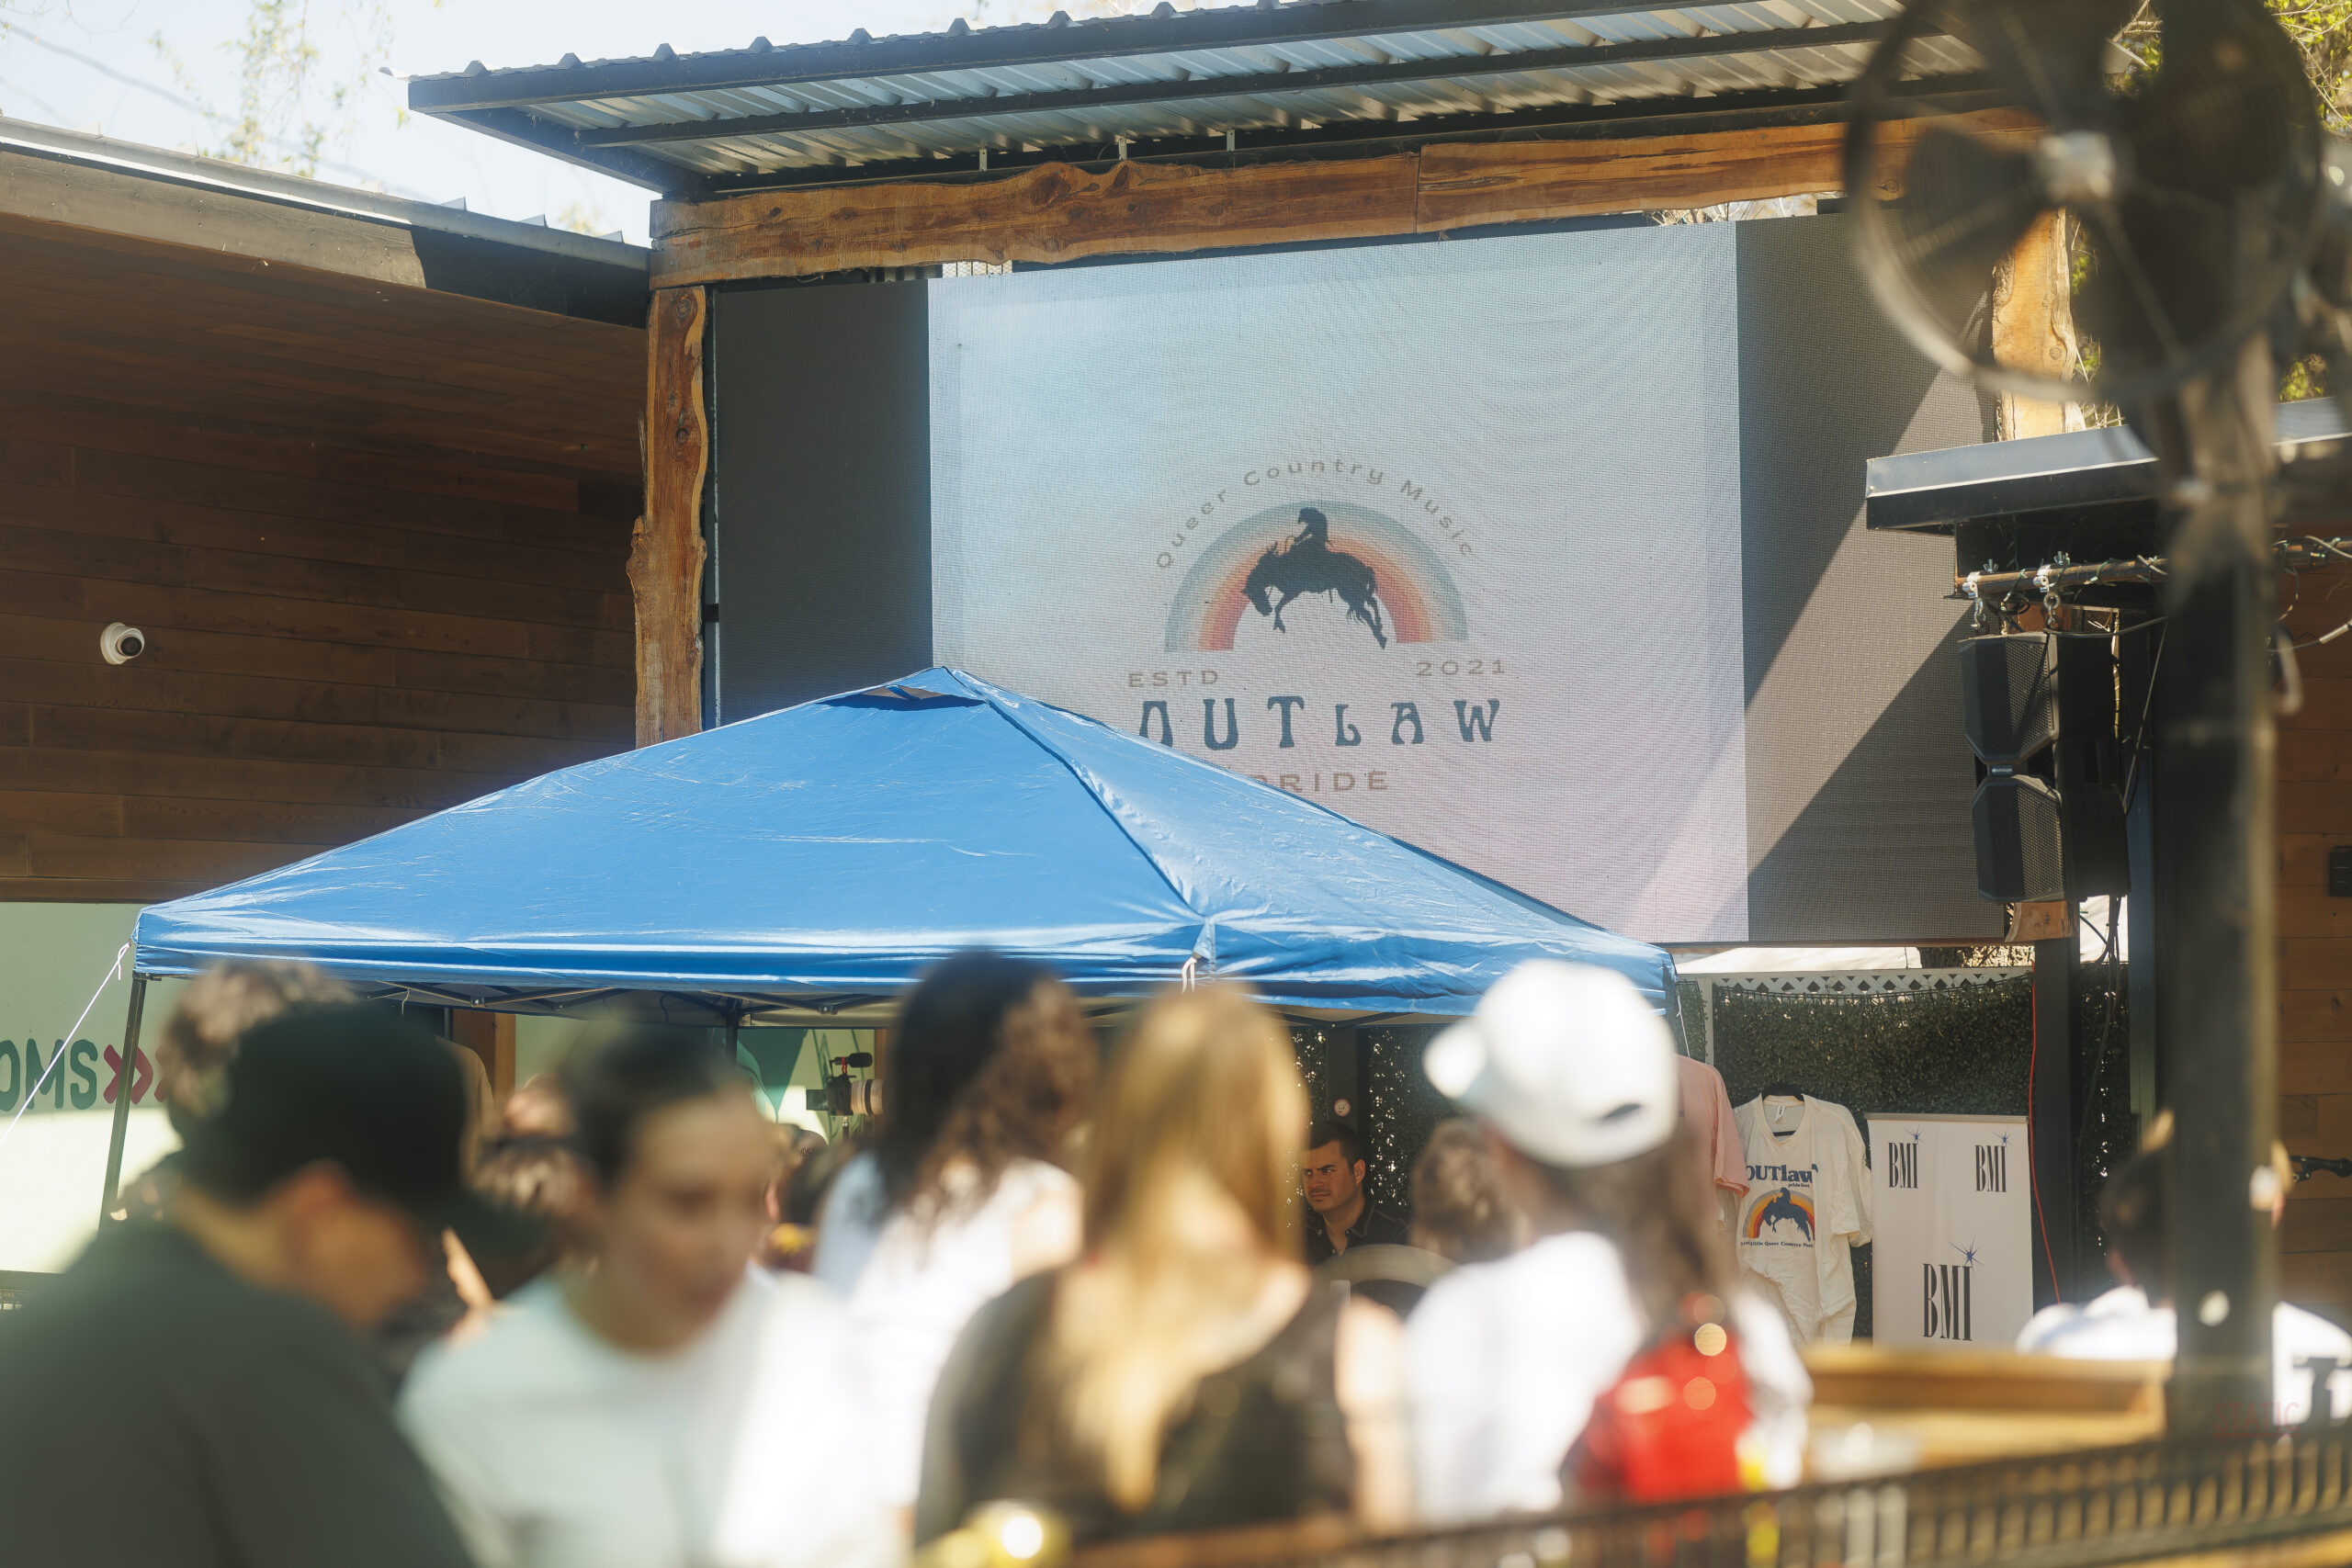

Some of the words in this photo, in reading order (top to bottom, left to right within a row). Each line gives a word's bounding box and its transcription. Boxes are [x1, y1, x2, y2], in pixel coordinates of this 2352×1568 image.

[1156, 488, 1227, 569] Queer
[1244, 459, 1384, 485] Country
[1400, 480, 1472, 556] Music
[1128, 670, 1220, 688] ESTD
[1416, 660, 1506, 677] 2021
[1139, 695, 1500, 750] OUTLAW
[1888, 1142, 1918, 1189] BMI
[1974, 1145, 2007, 1192] BMI
[1922, 1263, 1973, 1341] BMI
